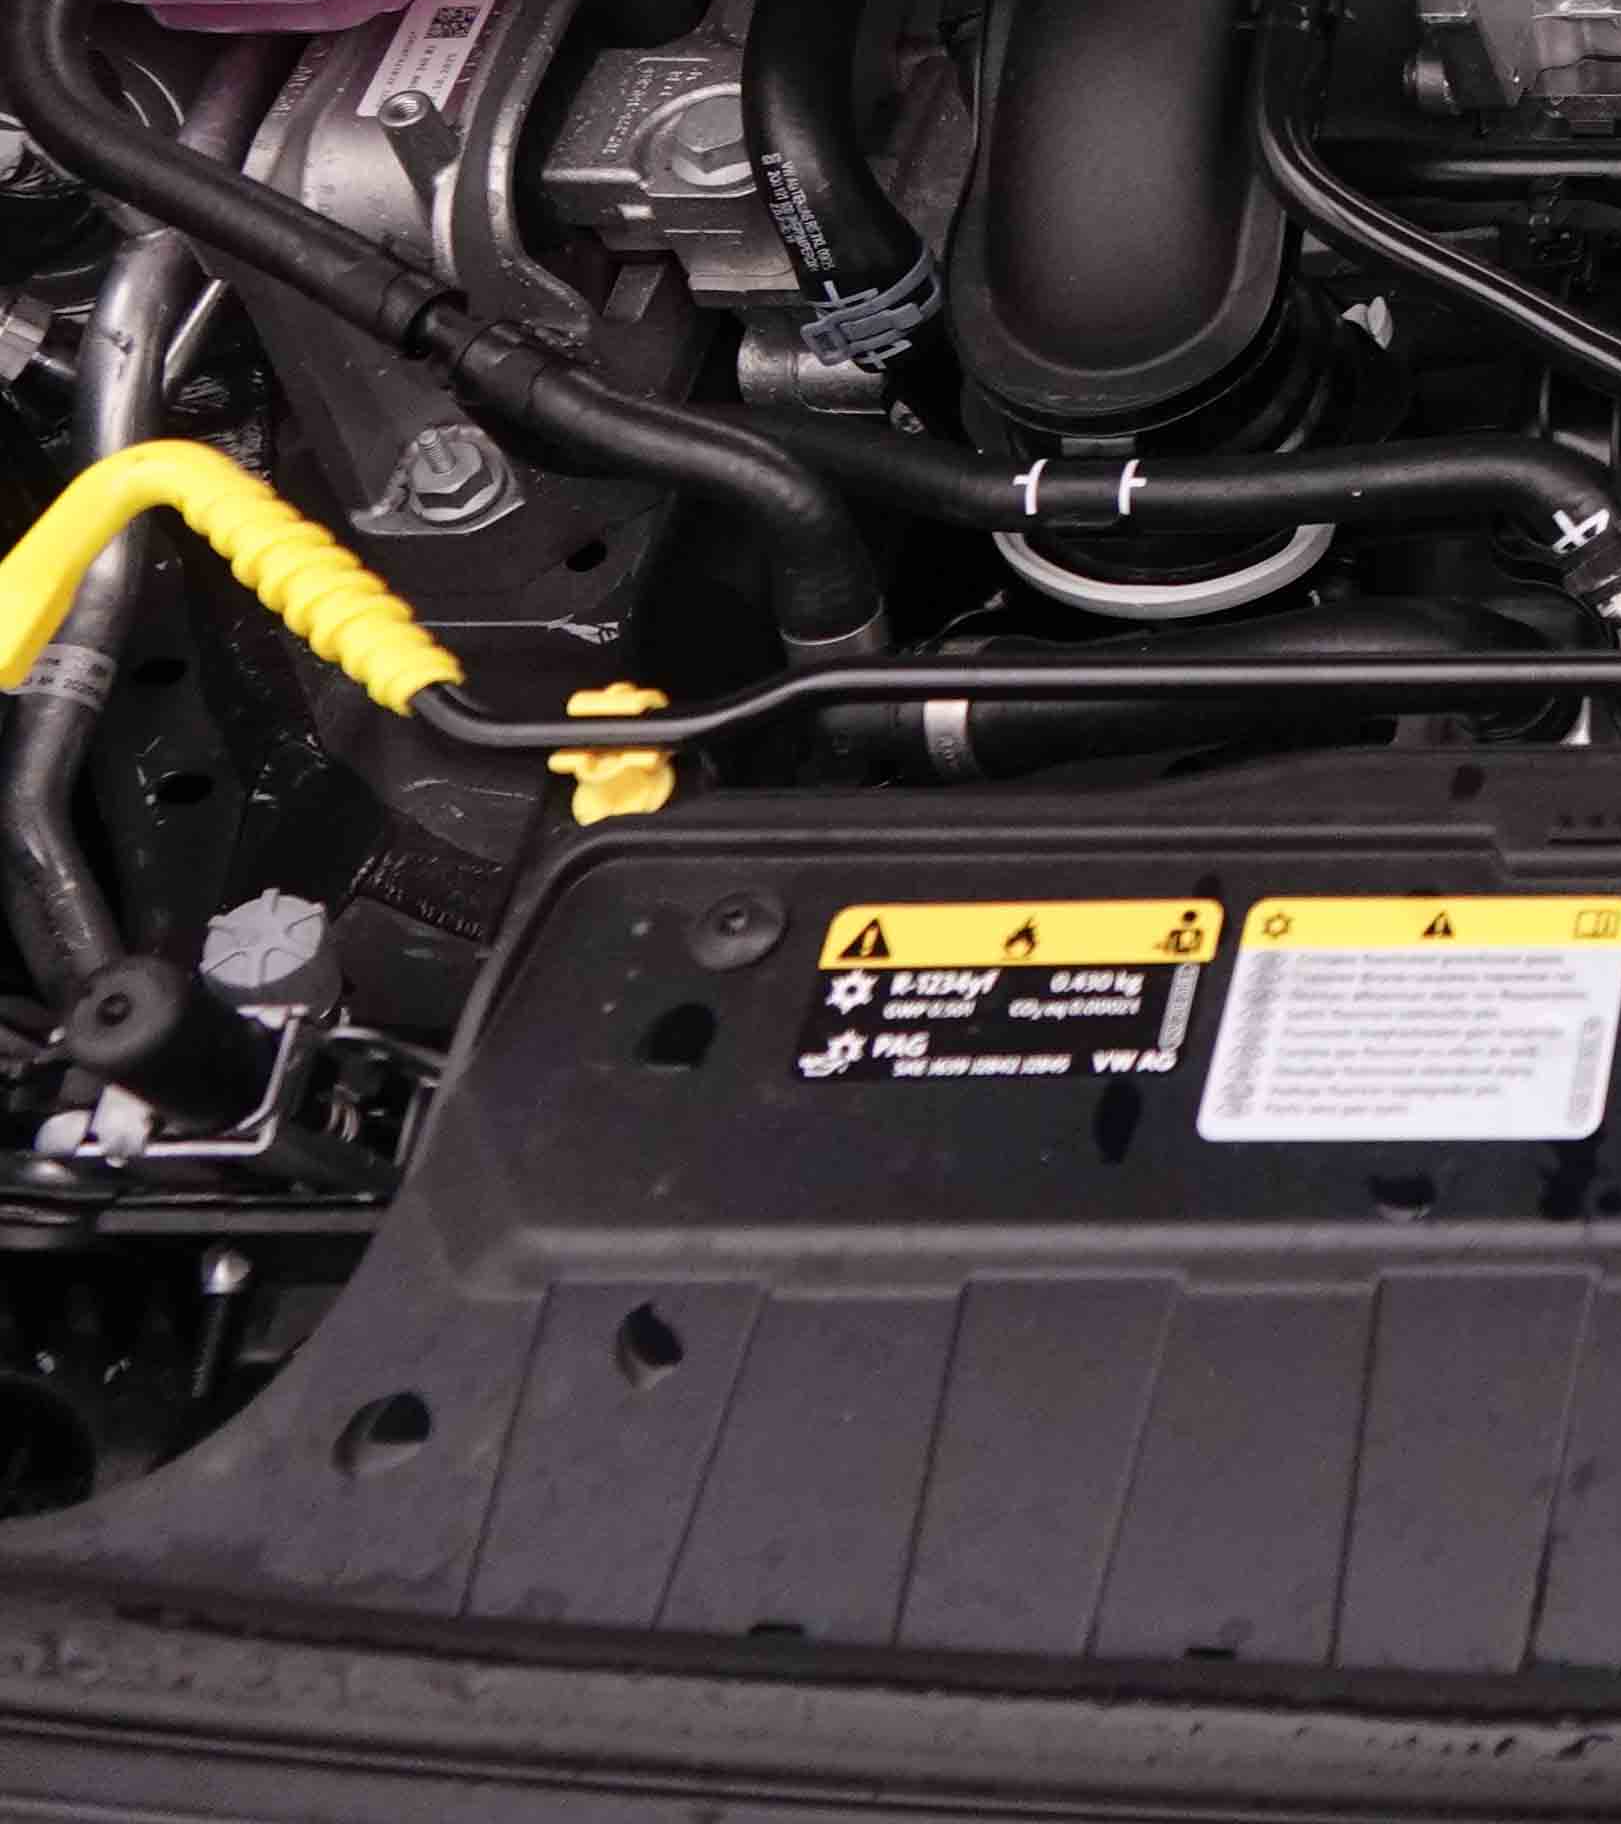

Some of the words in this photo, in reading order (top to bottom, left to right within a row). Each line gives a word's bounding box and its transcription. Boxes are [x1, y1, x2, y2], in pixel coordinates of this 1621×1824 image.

[889, 968, 1002, 1002] R-1234yf
[871, 1032, 932, 1060] PAG
[1091, 1048, 1140, 1073] VW
[1136, 1048, 1178, 1073] AG
